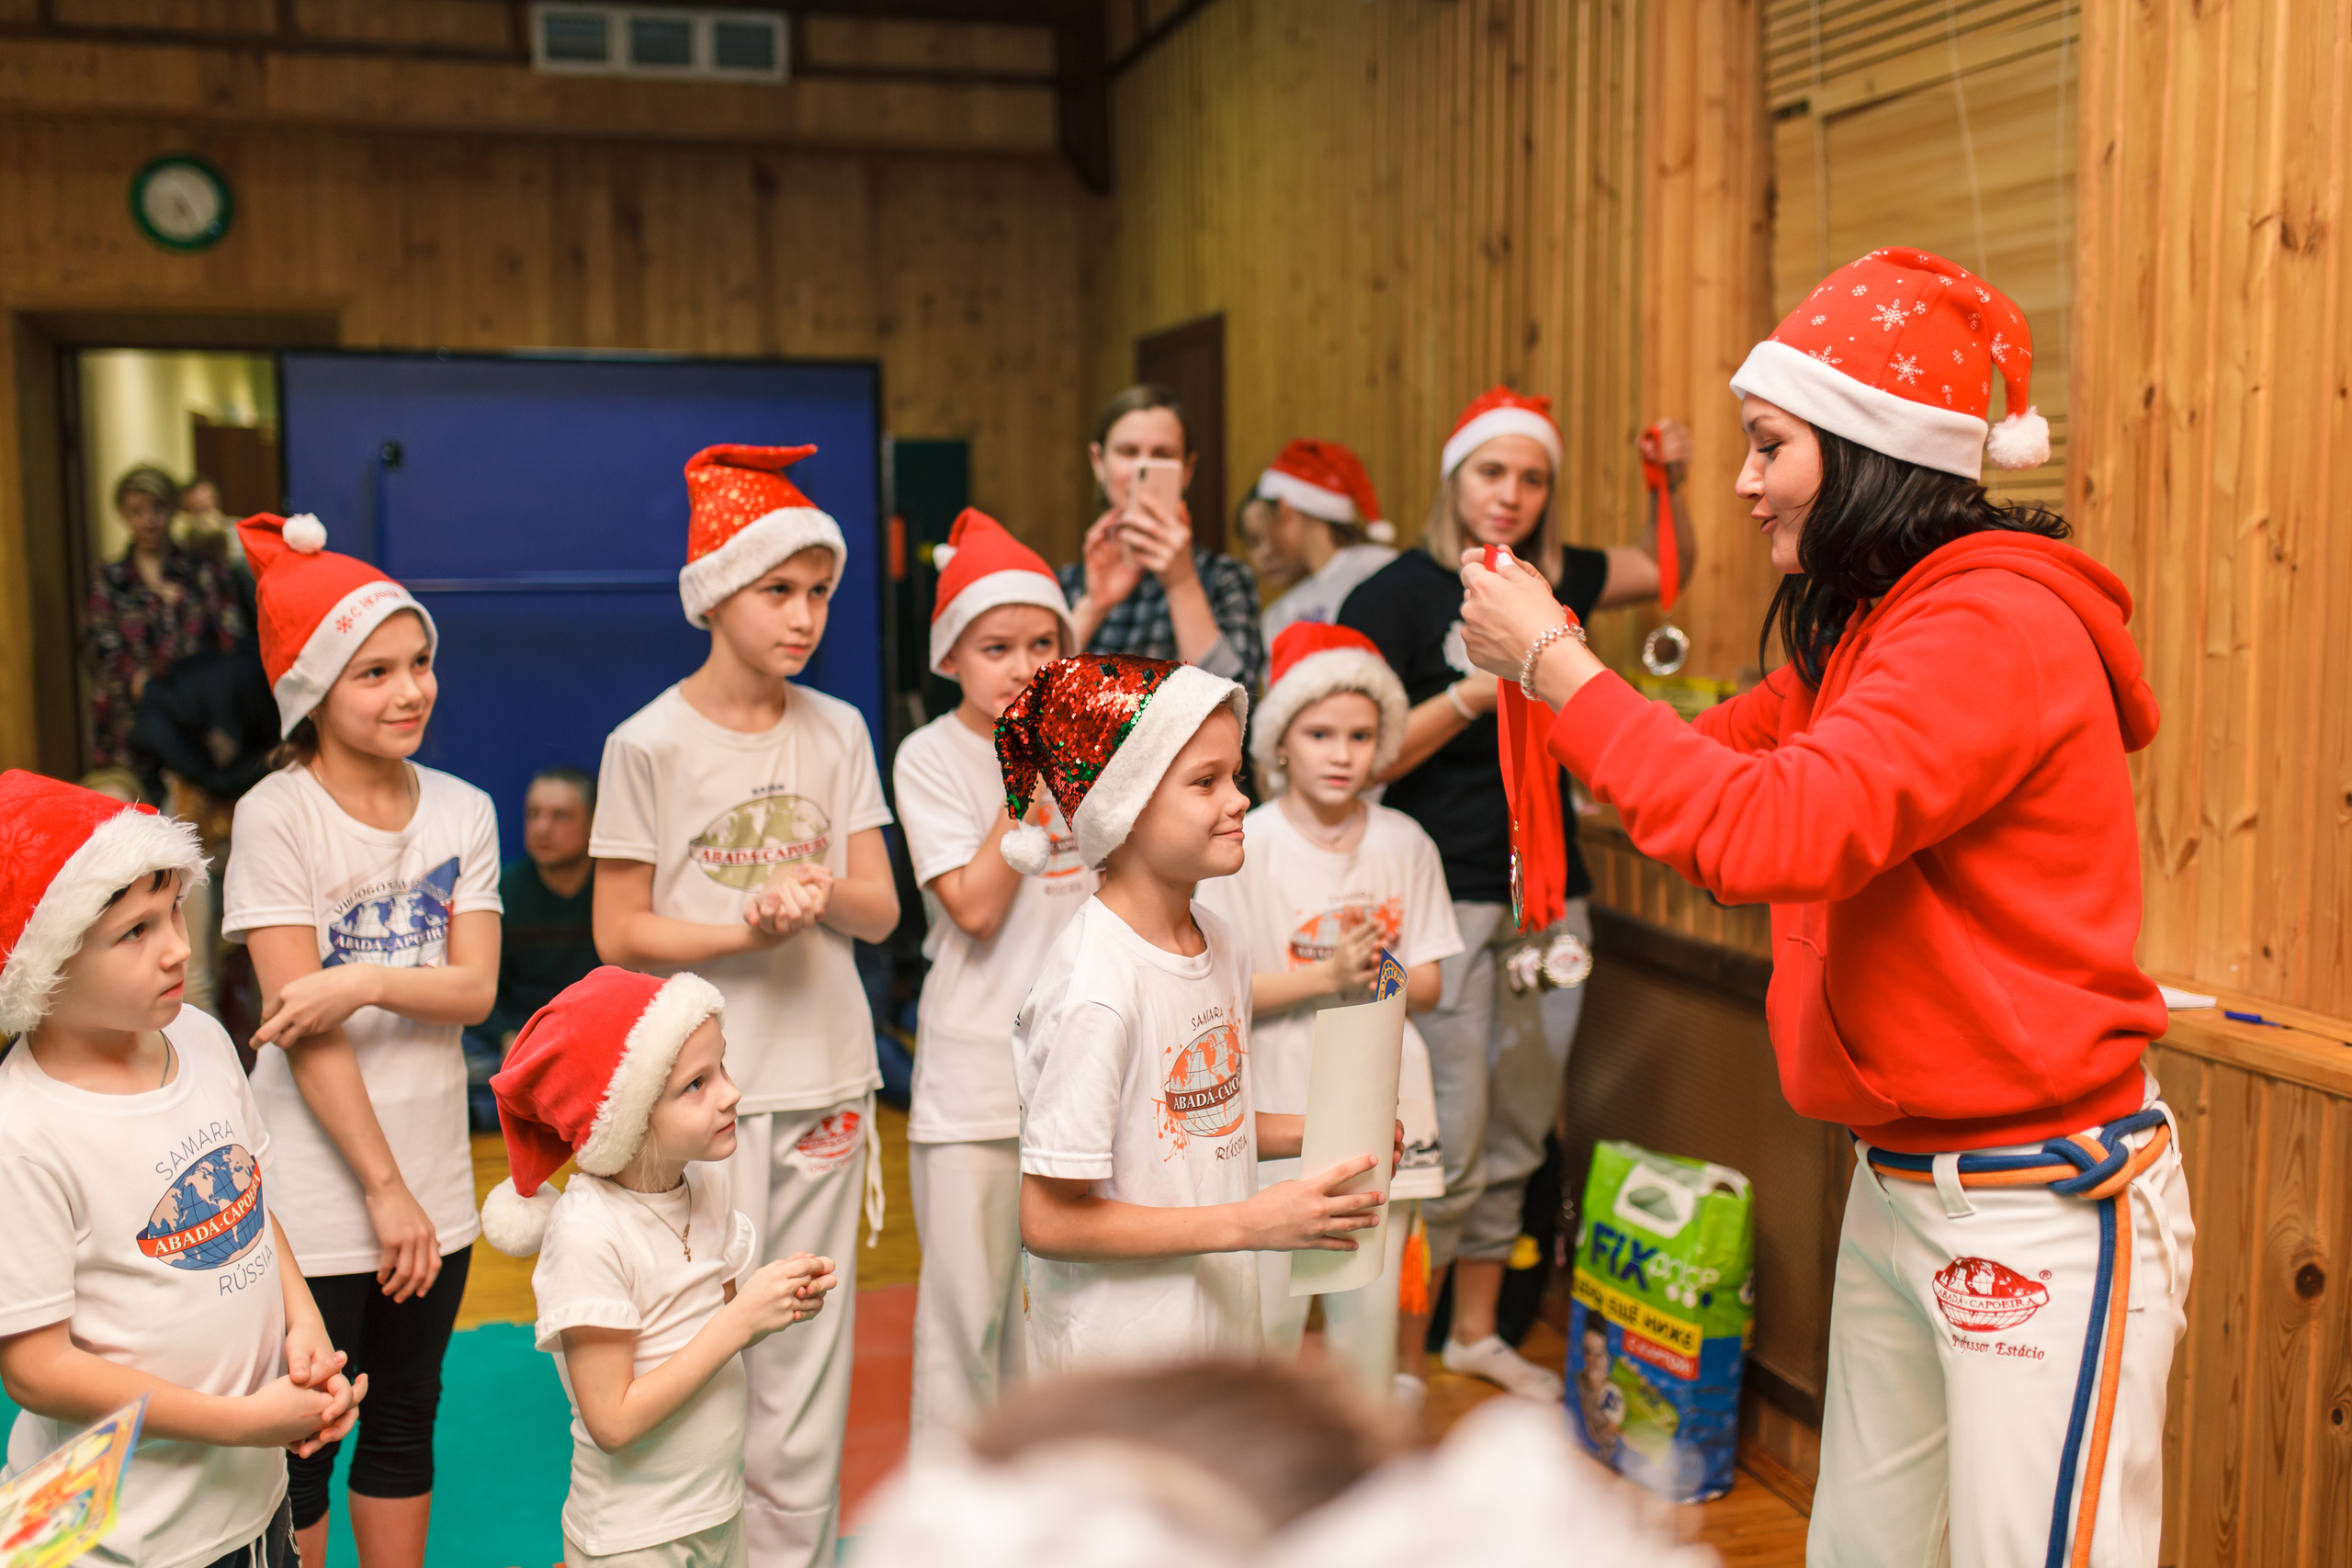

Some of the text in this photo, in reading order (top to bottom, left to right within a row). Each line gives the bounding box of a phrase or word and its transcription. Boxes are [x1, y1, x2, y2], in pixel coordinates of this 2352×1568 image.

[1191, 1006, 1224, 1032] SAMARA
[155, 1119, 235, 1181] SAMARA
[219, 1244, 274, 1296] RÚSSIA
[1996, 1342, 2044, 1360] Estácio
